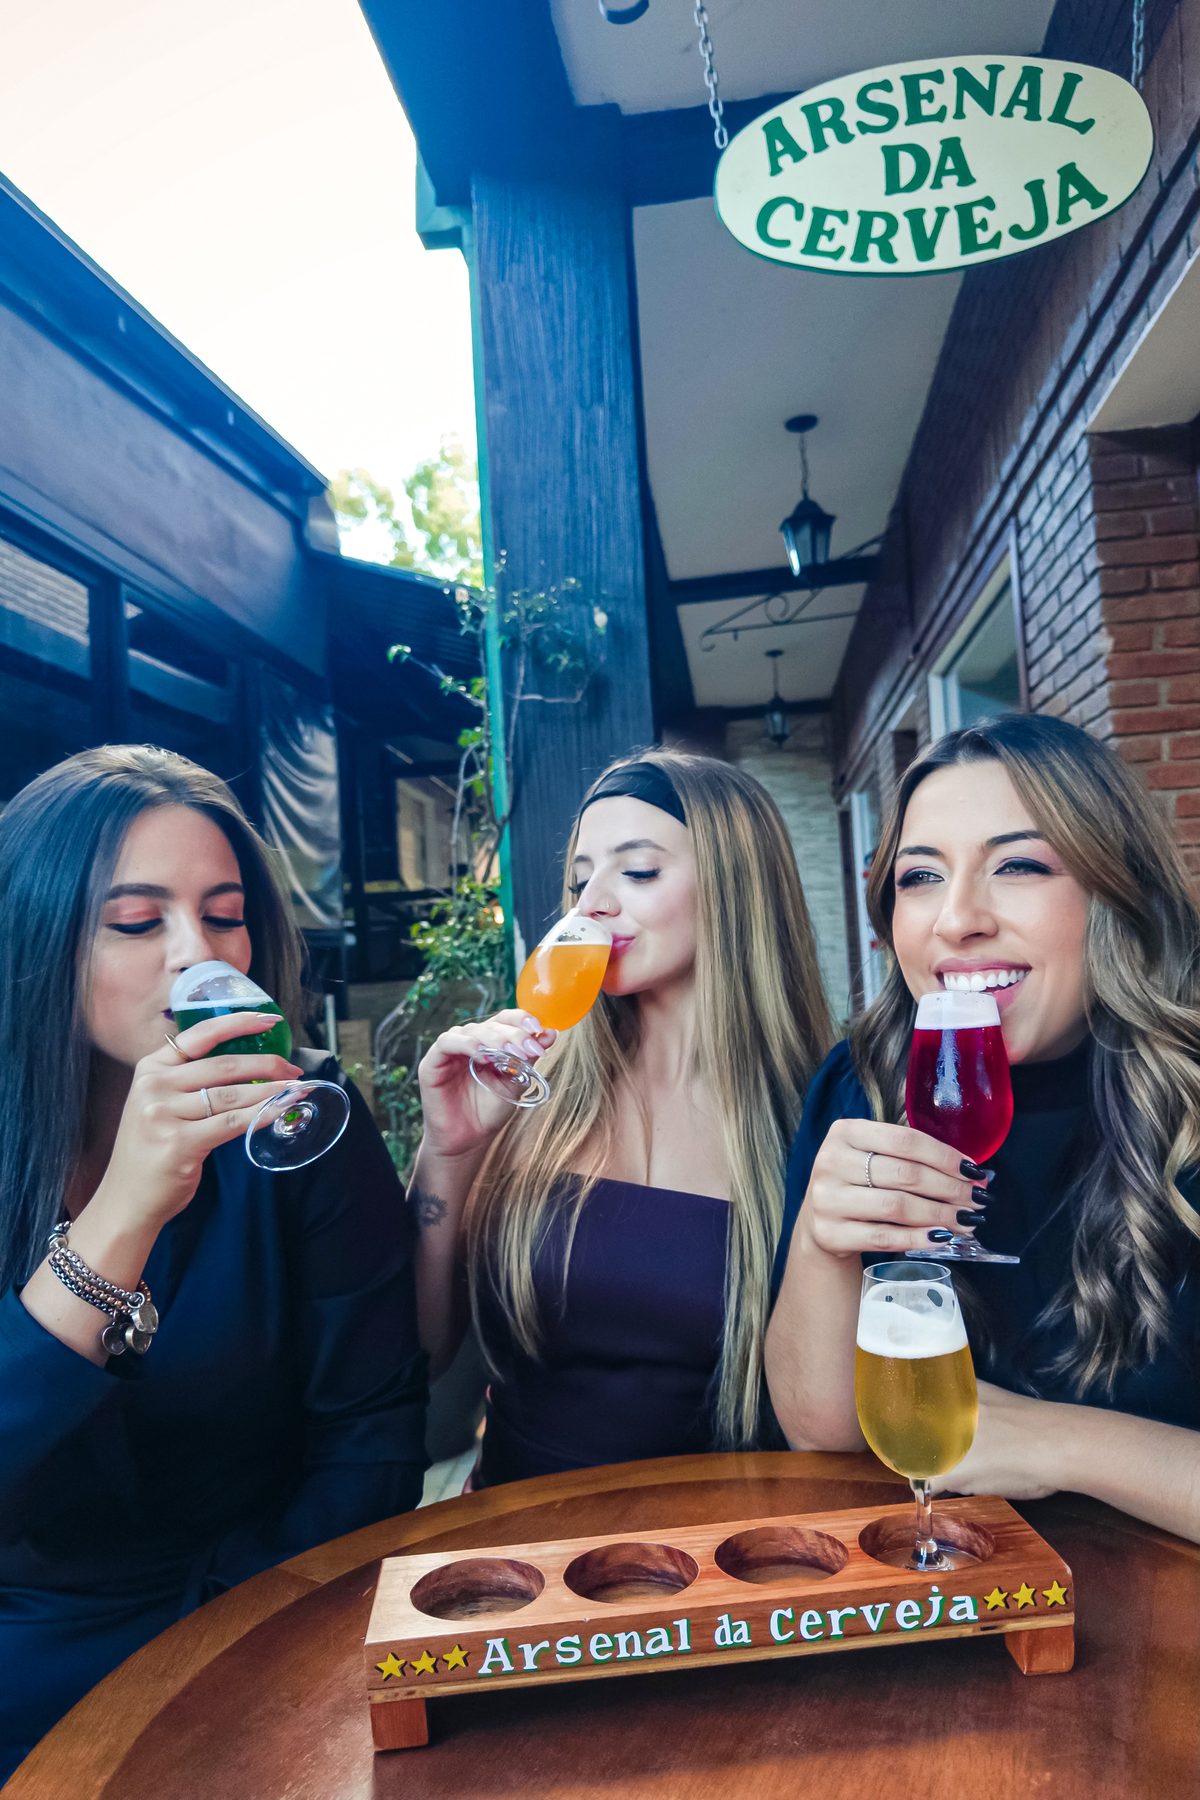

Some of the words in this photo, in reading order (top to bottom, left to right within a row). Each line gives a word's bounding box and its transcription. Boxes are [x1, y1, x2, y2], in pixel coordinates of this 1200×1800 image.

[761, 64, 1096, 177] ARSENAL
[881, 136, 977, 196] DA
[755, 161, 1109, 264] CERVEJA
[477, 1618, 692, 1677] Arsenal
[714, 1614, 752, 1647] da
[769, 1586, 979, 1643] Cerveja
